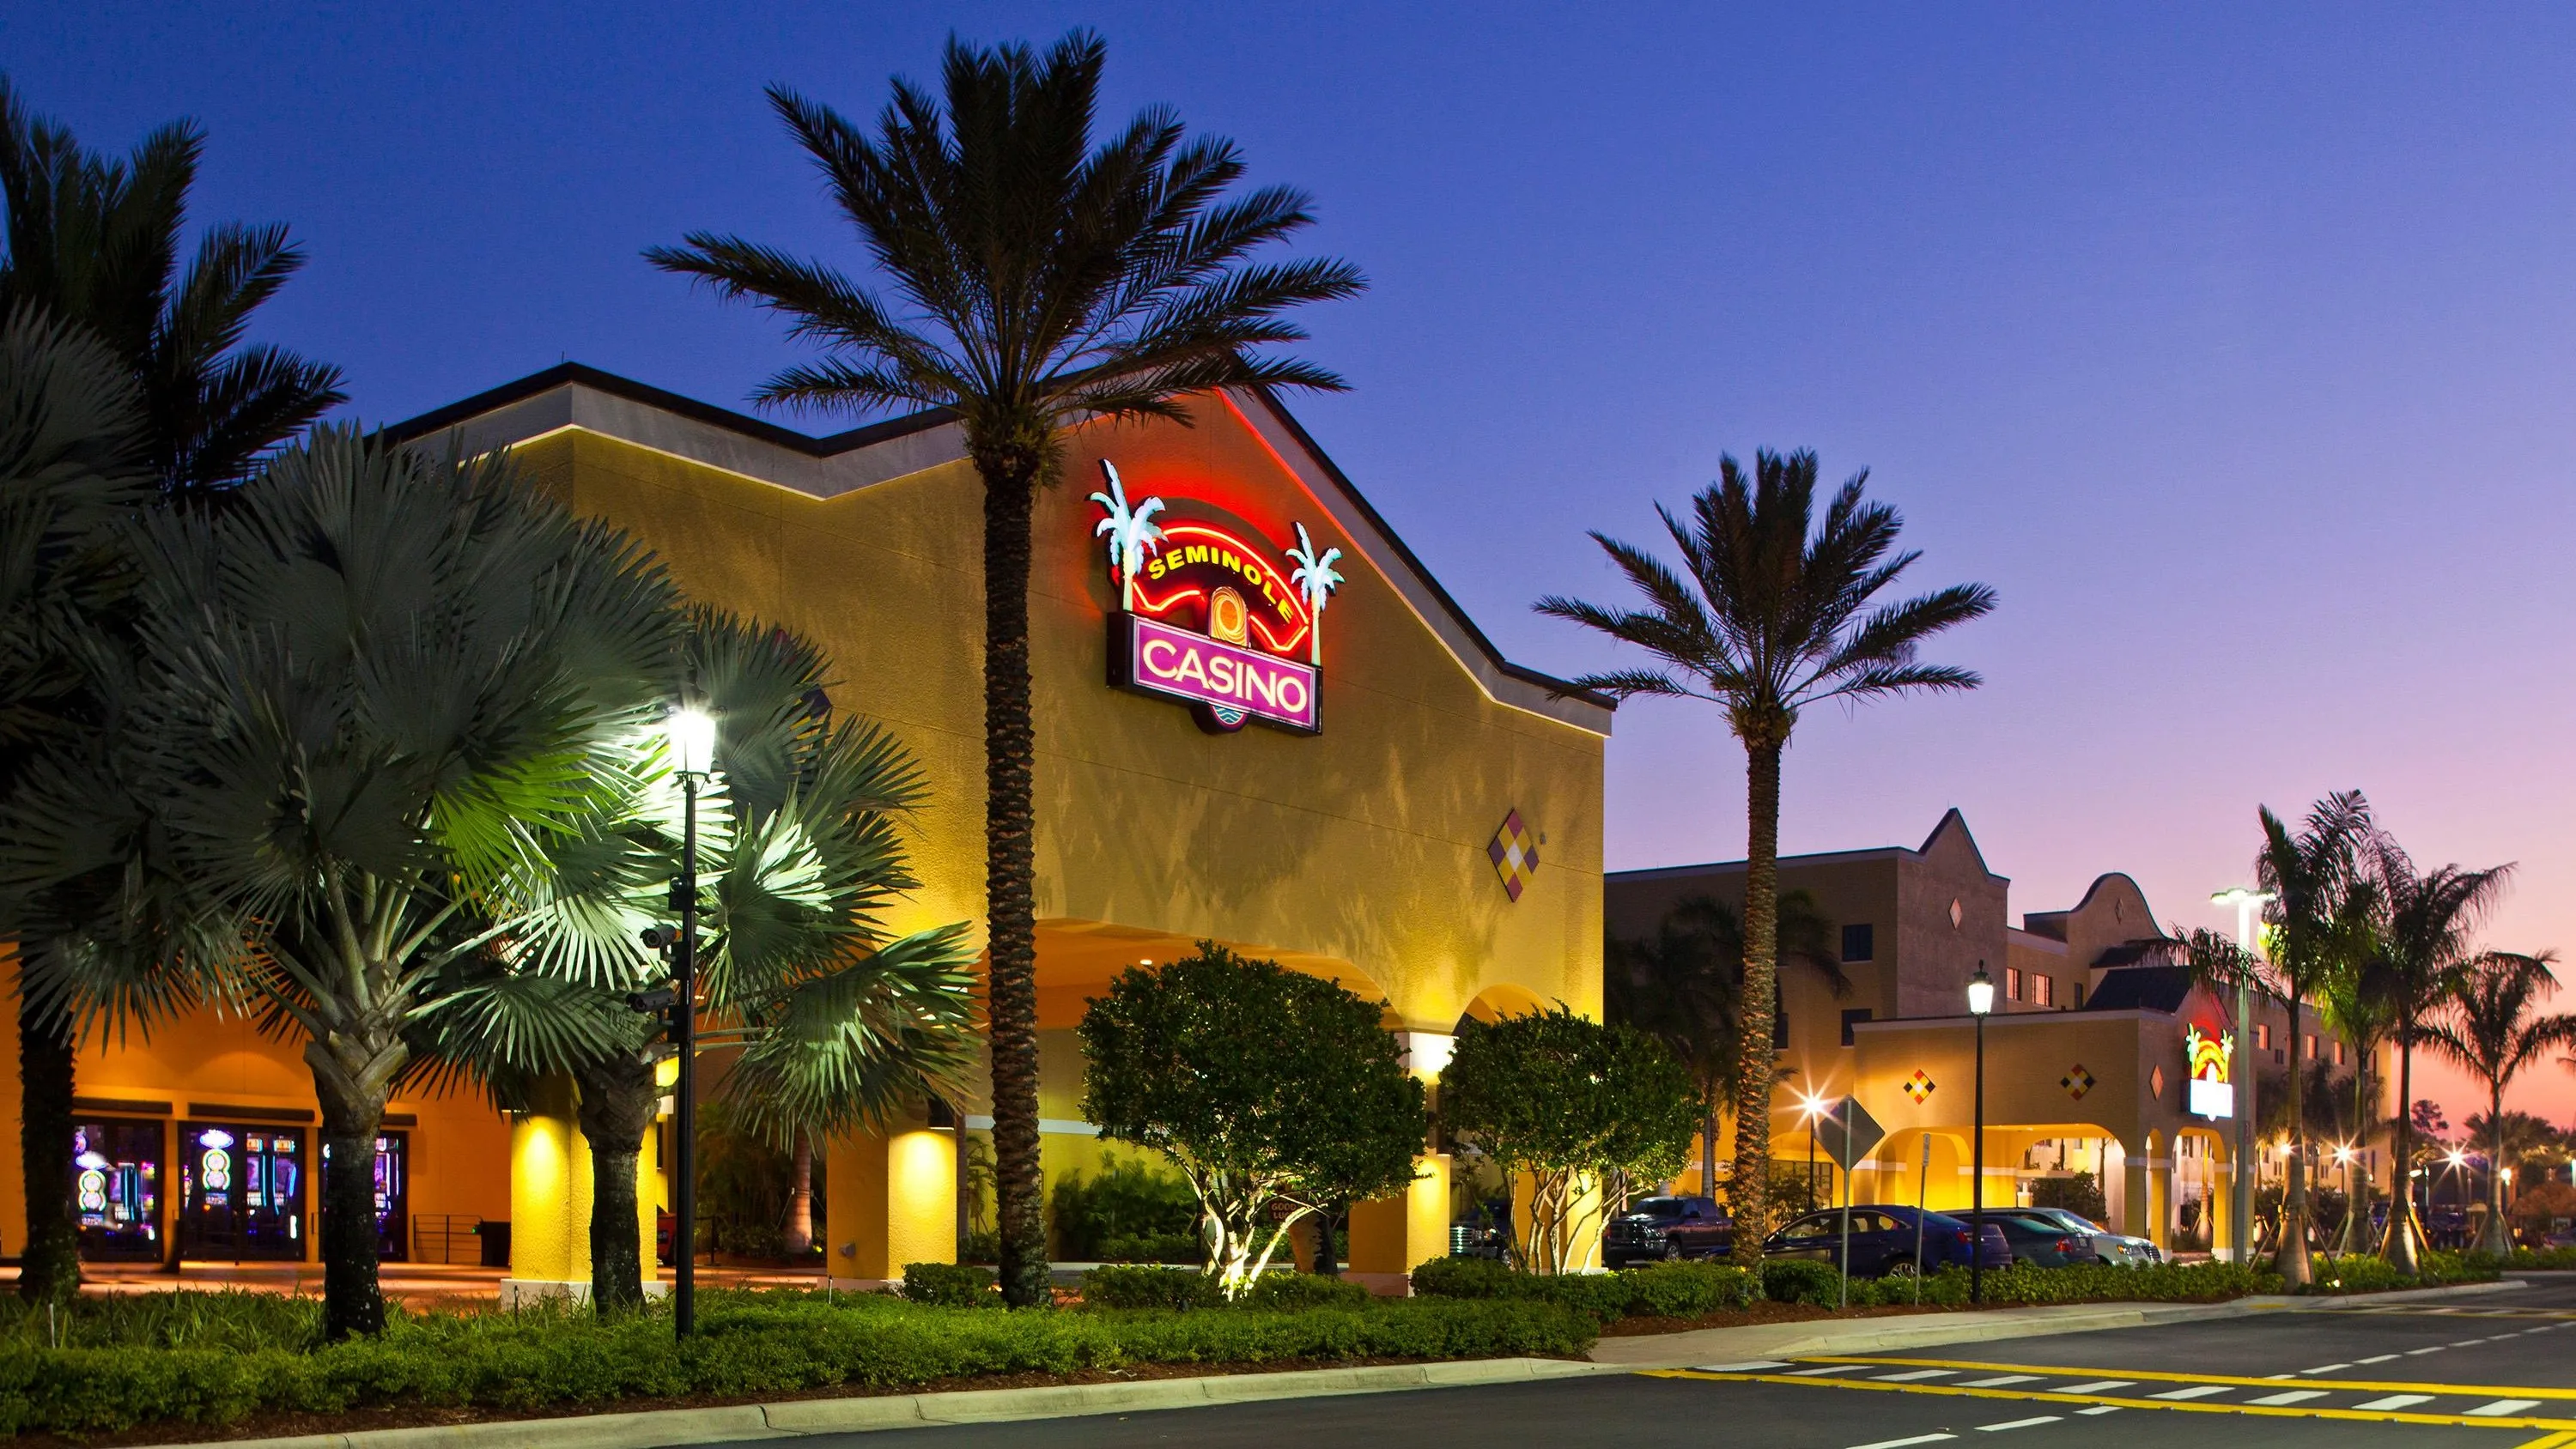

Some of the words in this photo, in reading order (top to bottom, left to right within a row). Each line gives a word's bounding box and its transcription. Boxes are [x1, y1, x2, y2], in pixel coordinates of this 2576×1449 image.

[1148, 545, 1293, 624] SEMINOLE
[1142, 640, 1307, 712] CASINO
[1271, 1203, 1297, 1211] GOOD
